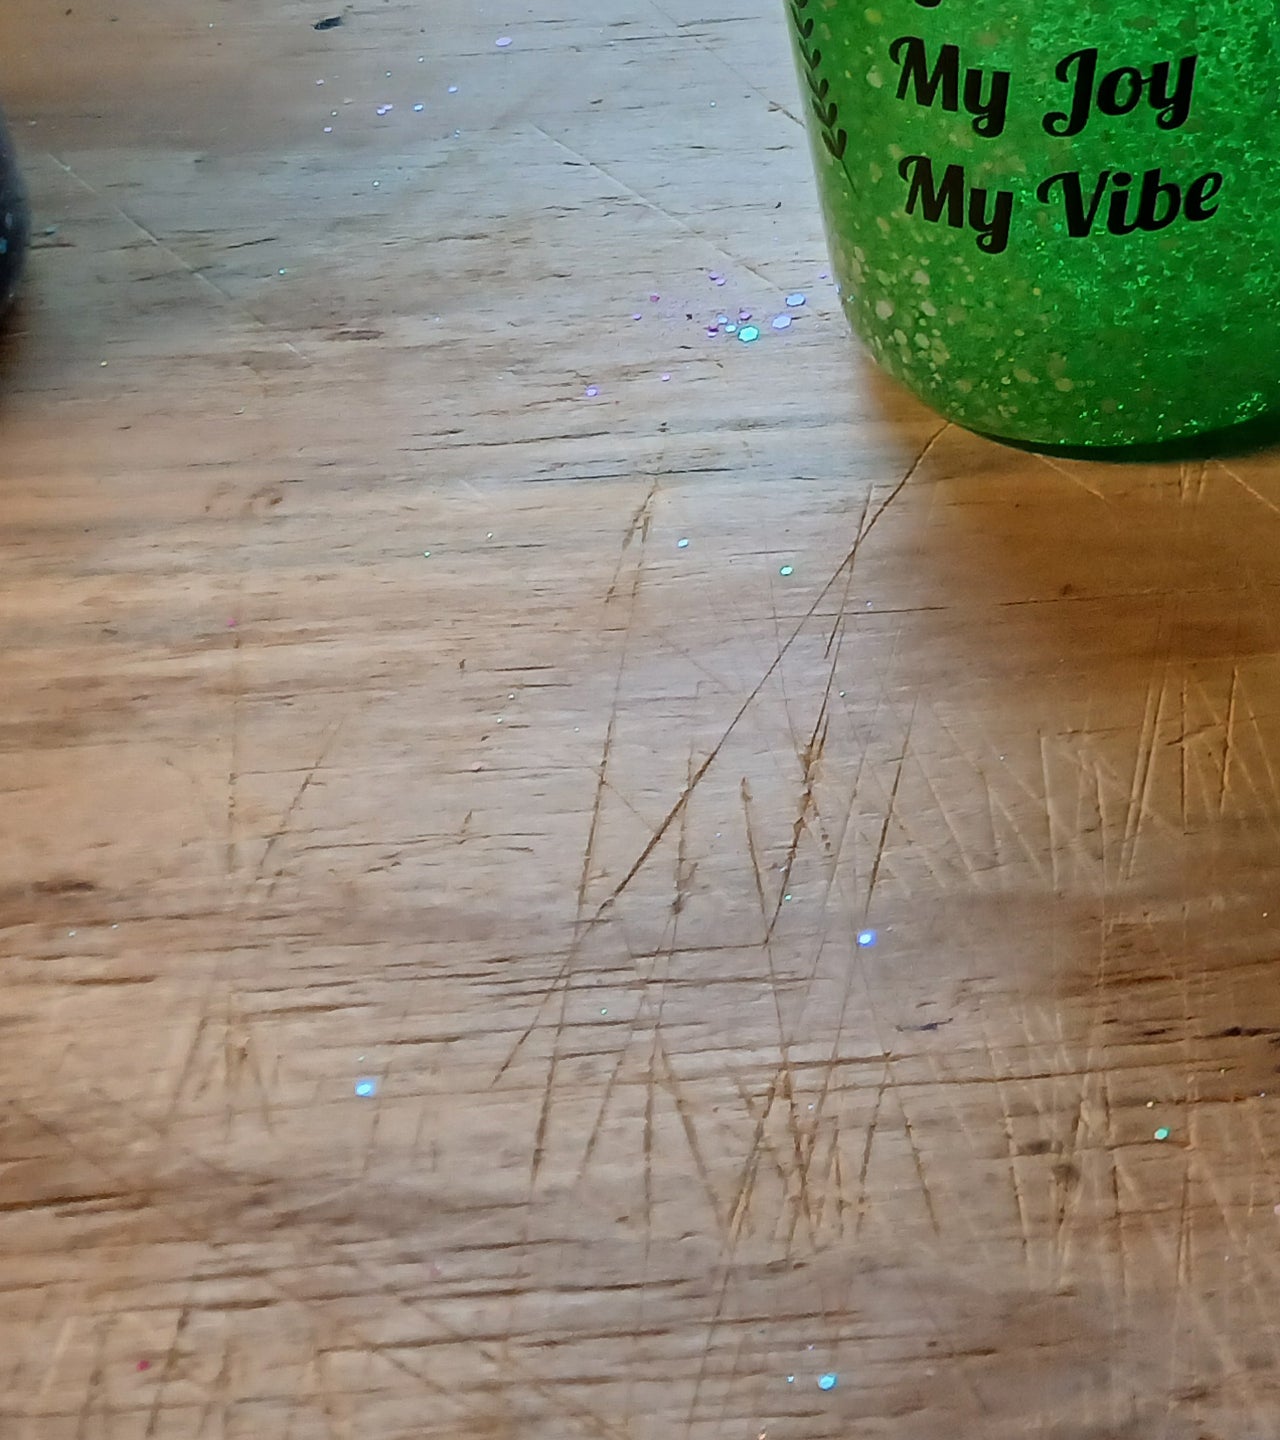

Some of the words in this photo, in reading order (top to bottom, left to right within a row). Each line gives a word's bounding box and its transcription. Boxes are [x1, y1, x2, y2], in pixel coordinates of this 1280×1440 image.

[889, 36, 1009, 137] My
[1042, 47, 1199, 136] Joy
[898, 155, 1013, 253] My
[1036, 167, 1223, 237] Vibe
